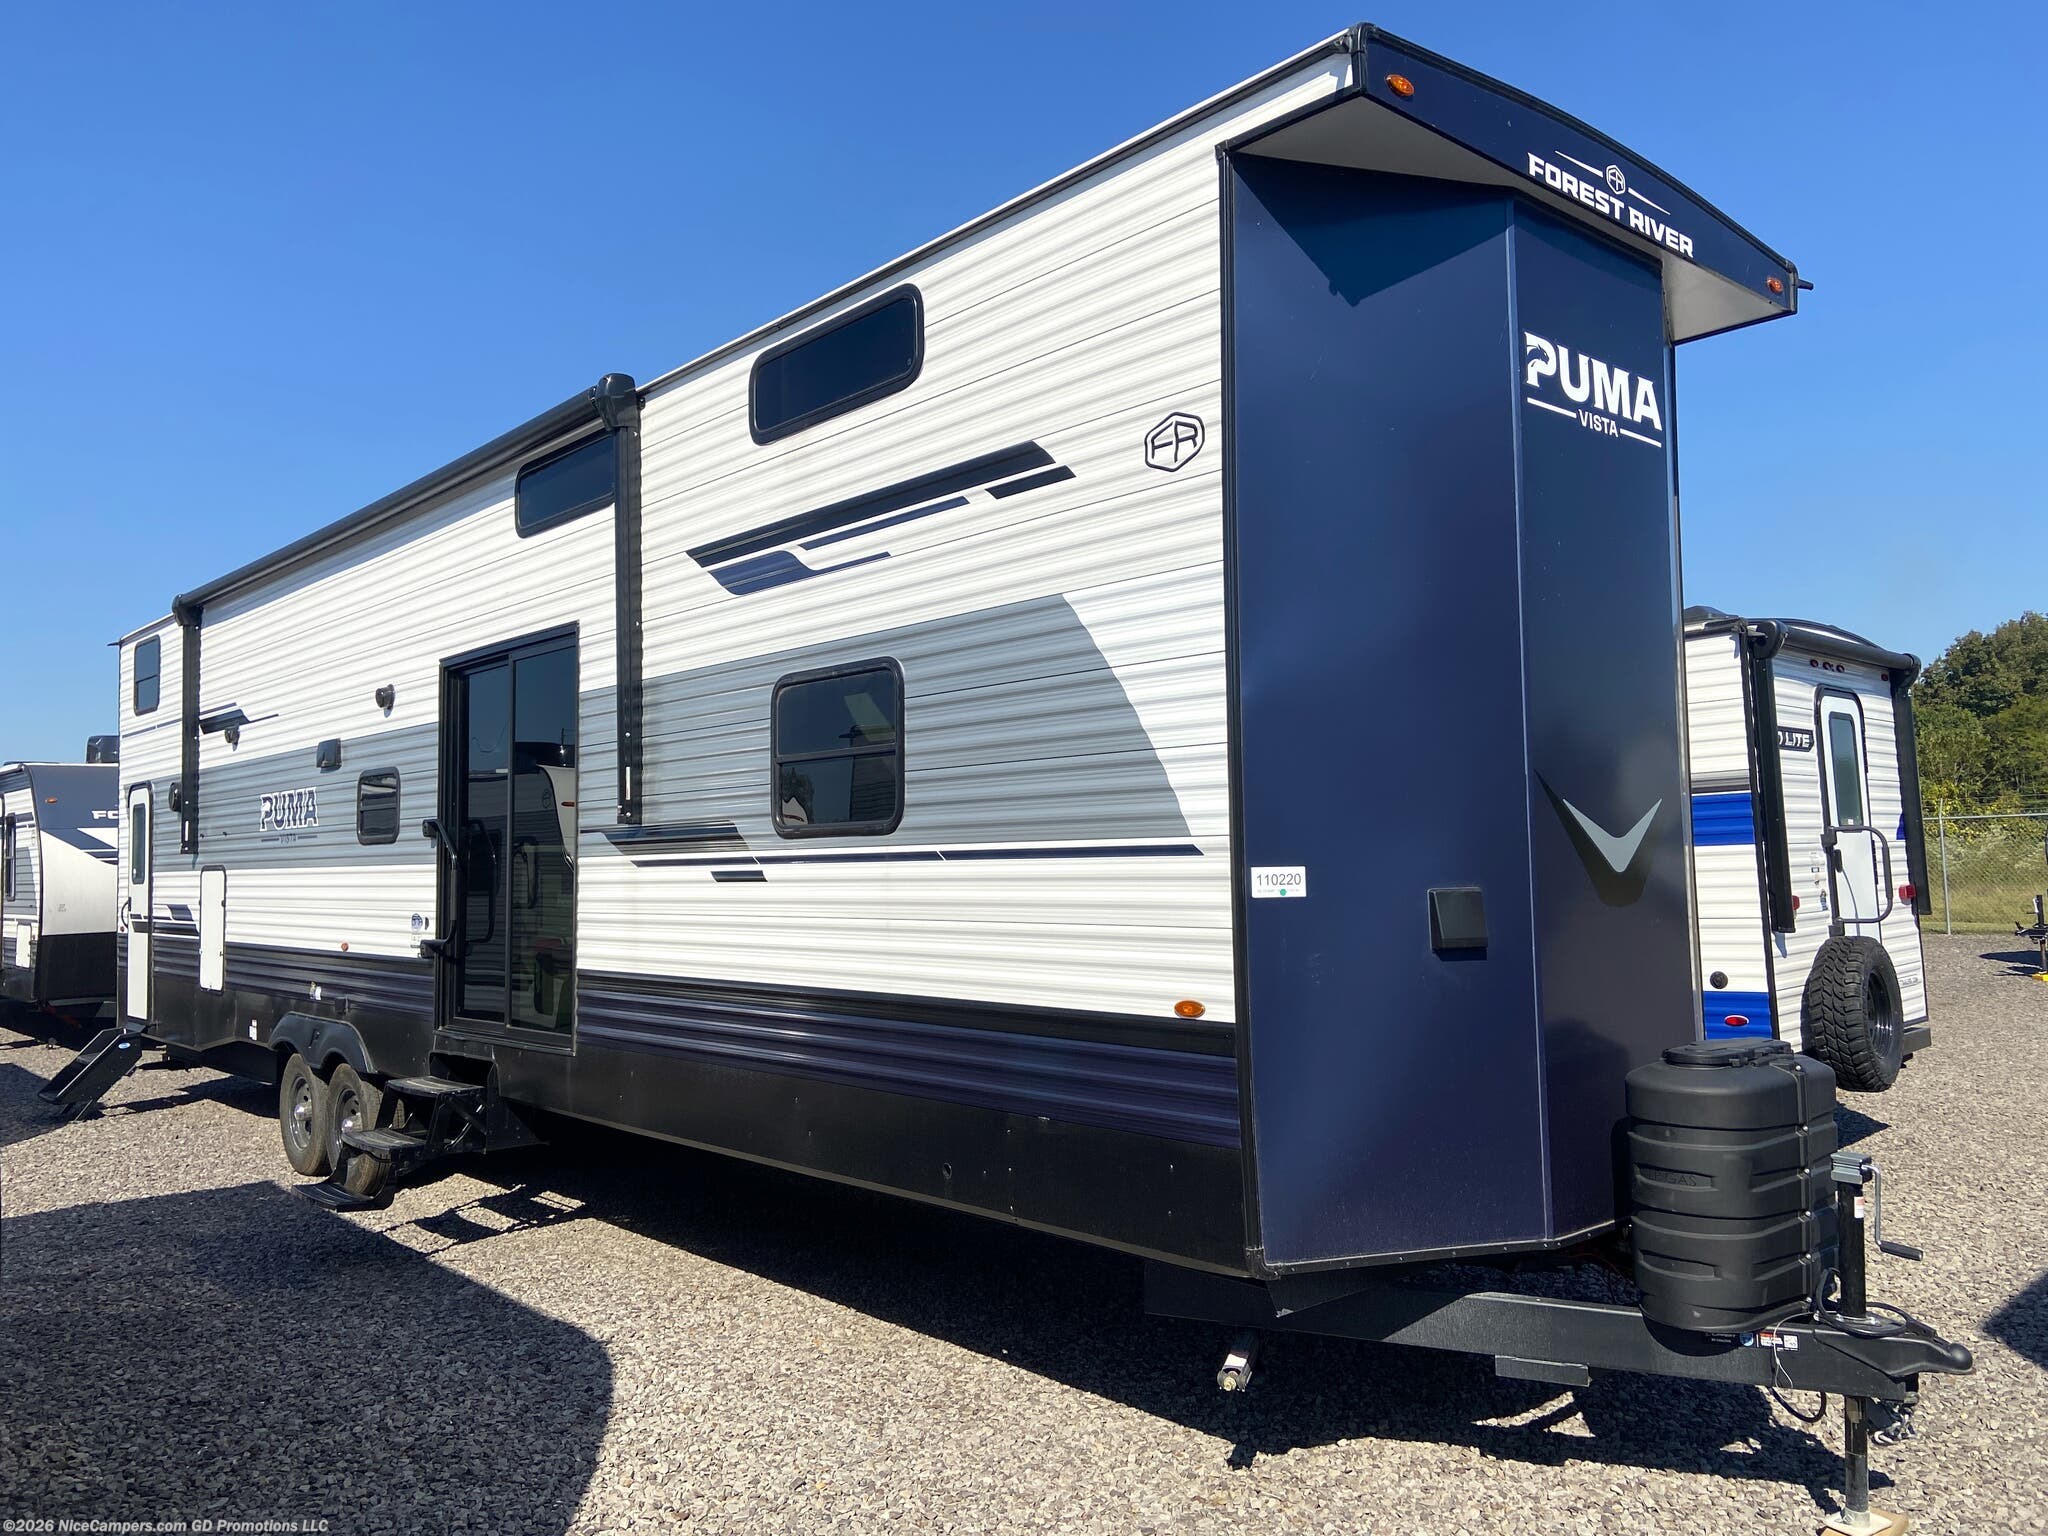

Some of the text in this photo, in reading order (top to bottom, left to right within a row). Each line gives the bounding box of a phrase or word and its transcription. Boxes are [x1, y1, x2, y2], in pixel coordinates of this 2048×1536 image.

[1527, 152, 1694, 259] FOREST RIVER
[1524, 331, 1663, 431] PUMA
[1578, 409, 1619, 438] VISTA
[1785, 731, 1810, 748] LITE
[260, 787, 319, 831] PUMA
[1256, 873, 1302, 886] 110220
[1665, 1172, 1697, 1187] GAS
